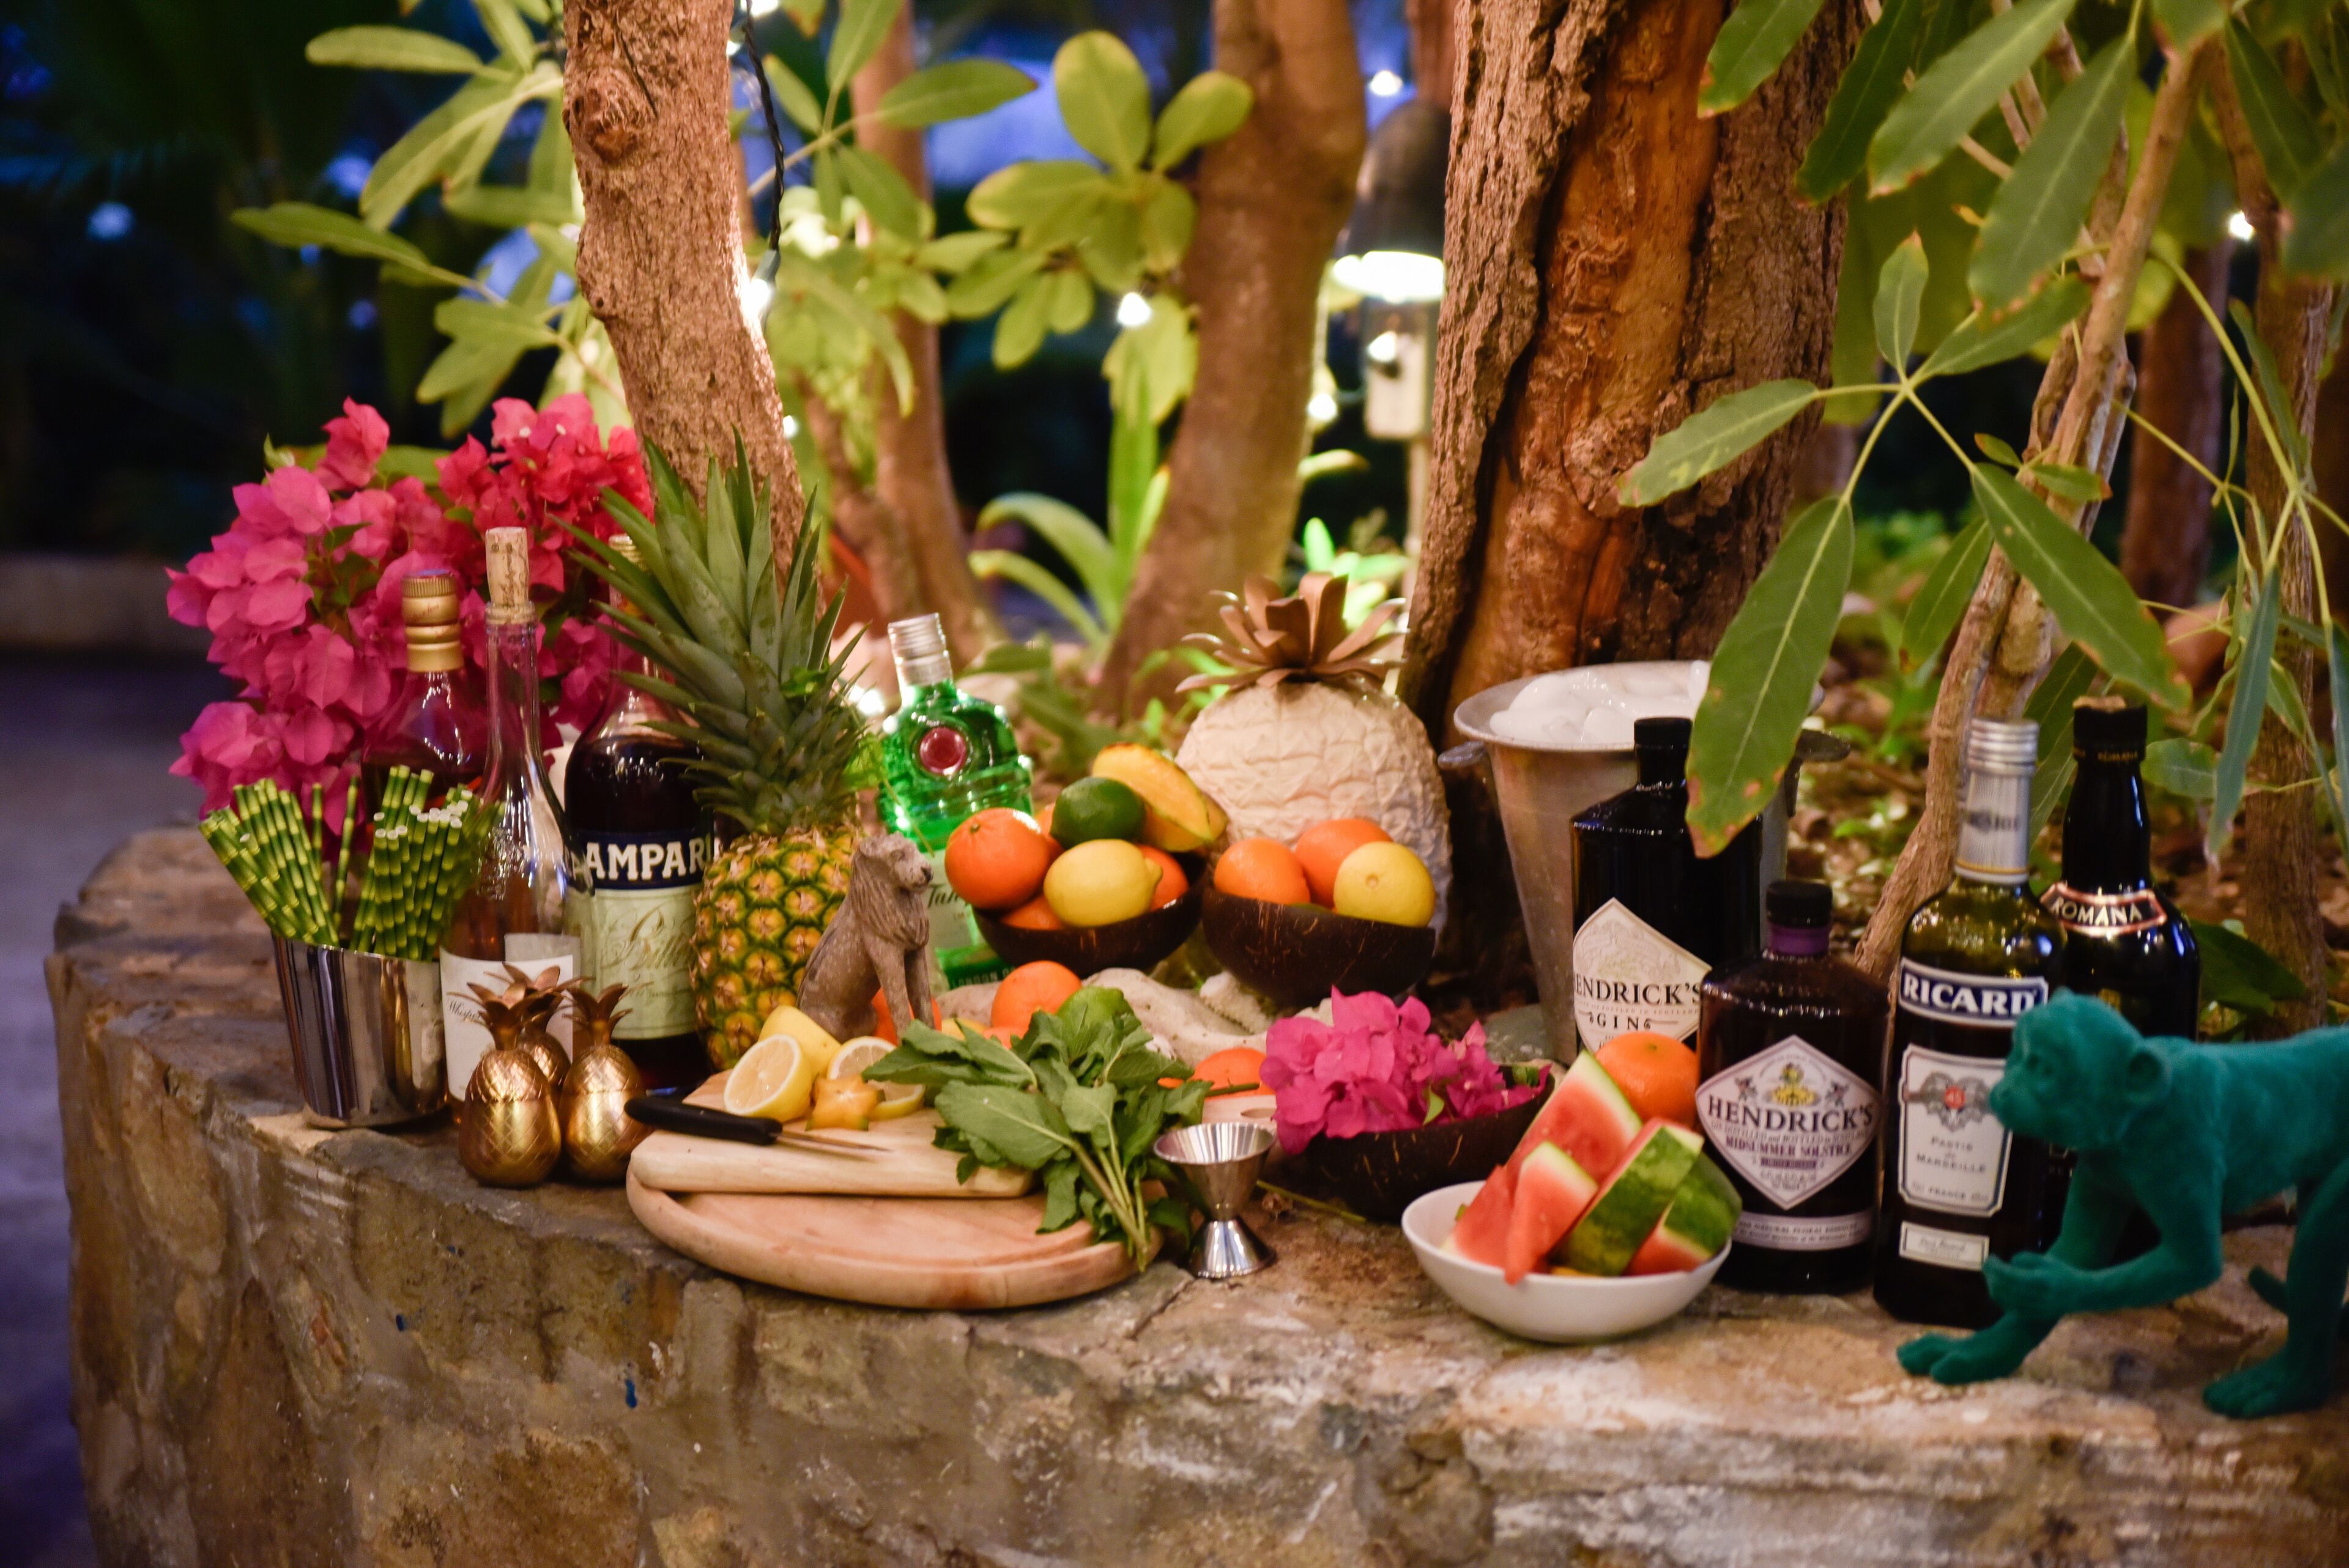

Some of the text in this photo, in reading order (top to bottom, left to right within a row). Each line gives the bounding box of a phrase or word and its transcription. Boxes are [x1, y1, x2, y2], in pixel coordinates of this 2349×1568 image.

[1903, 972, 2035, 1016] RICARD
[1597, 1013, 1639, 1031] GIN
[1709, 1094, 1872, 1132] HENDRICK'S
